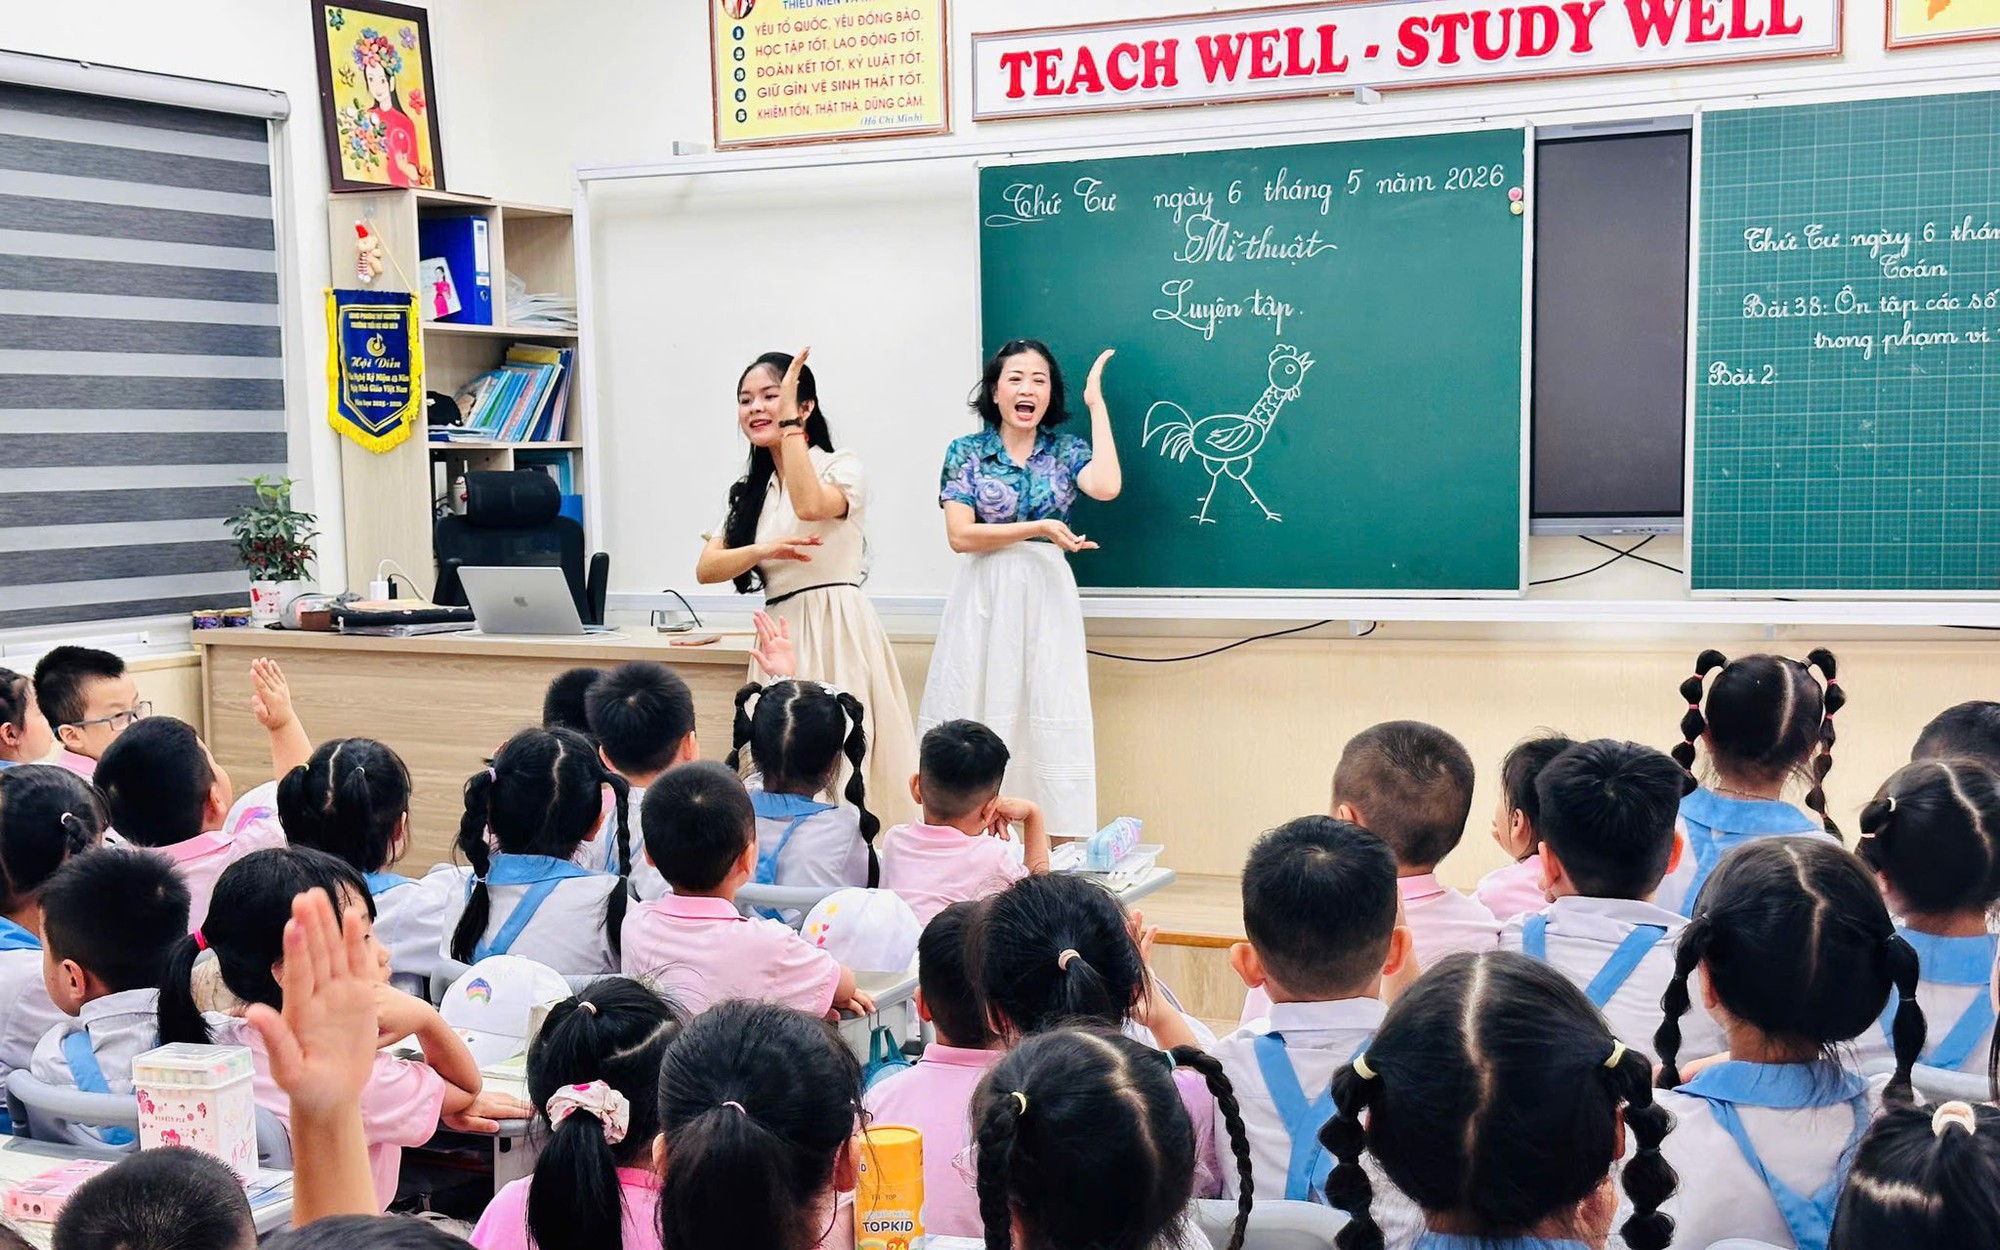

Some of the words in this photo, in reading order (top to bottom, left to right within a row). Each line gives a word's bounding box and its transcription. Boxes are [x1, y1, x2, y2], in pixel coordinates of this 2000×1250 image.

[755, 22, 774, 36] YÊU
[777, 17, 791, 34] TỔ
[834, 13, 854, 28] YÊU
[755, 43, 781, 58] HỌC
[784, 39, 805, 54] TẬP
[833, 36, 857, 49] LAO
[860, 32, 897, 48] ĐỘNG
[900, 27, 924, 42] TỐT.
[1000, 38, 1179, 99] TEACH
[1196, 23, 1349, 84] WELL
[1363, 44, 1381, 59] -
[1396, 1, 1604, 69] STUDY
[1625, 0, 1804, 48] WELL
[757, 62, 794, 77] ĐOÀN
[797, 59, 817, 74] KẾT
[867, 52, 896, 69] LUẬT
[899, 49, 925, 64] TỐT.
[757, 83, 781, 98] GIỮ
[784, 81, 808, 96] GÌN
[811, 79, 828, 94] VỆ
[831, 79, 861, 92] SINH
[864, 74, 895, 90] THẬT
[898, 70, 925, 86] TỐT.
[756, 104, 788, 120] KHIÊM
[815, 100, 839, 116] THẬT
[864, 96, 895, 111] DŨNG
[994, 183, 1063, 222] Thứ
[1073, 176, 1117, 213] Tư
[1153, 186, 1213, 224] ngày
[1227, 179, 1243, 205] 6
[1264, 166, 1333, 216] tháng
[1347, 168, 1364, 195] 5
[1375, 172, 1437, 195] năm
[1443, 163, 1505, 190] 2026
[1173, 213, 1244, 264] Mĩ
[1237, 225, 1339, 266] thuật
[1743, 226, 1799, 253] Thứ
[1803, 223, 1840, 250] Tư
[1850, 227, 1911, 260] ngày
[1922, 221, 1936, 243] 6
[1879, 253, 1948, 279] Toán
[1152, 278, 1244, 341] Luyện
[1742, 292, 1789, 319] Bài
[1793, 295, 1829, 317] 38:
[1834, 284, 1873, 315] Ôn
[1879, 296, 1919, 320] tập
[1925, 292, 1961, 311] các
[1967, 288, 2000, 310] số
[1813, 331, 1874, 361] trong
[1882, 320, 1960, 355] phạm
[1965, 326, 1990, 343] vi
[351, 356, 372, 369] Hội
[1708, 360, 1756, 386] Bài
[862, 1220, 914, 1233] TOPKID
